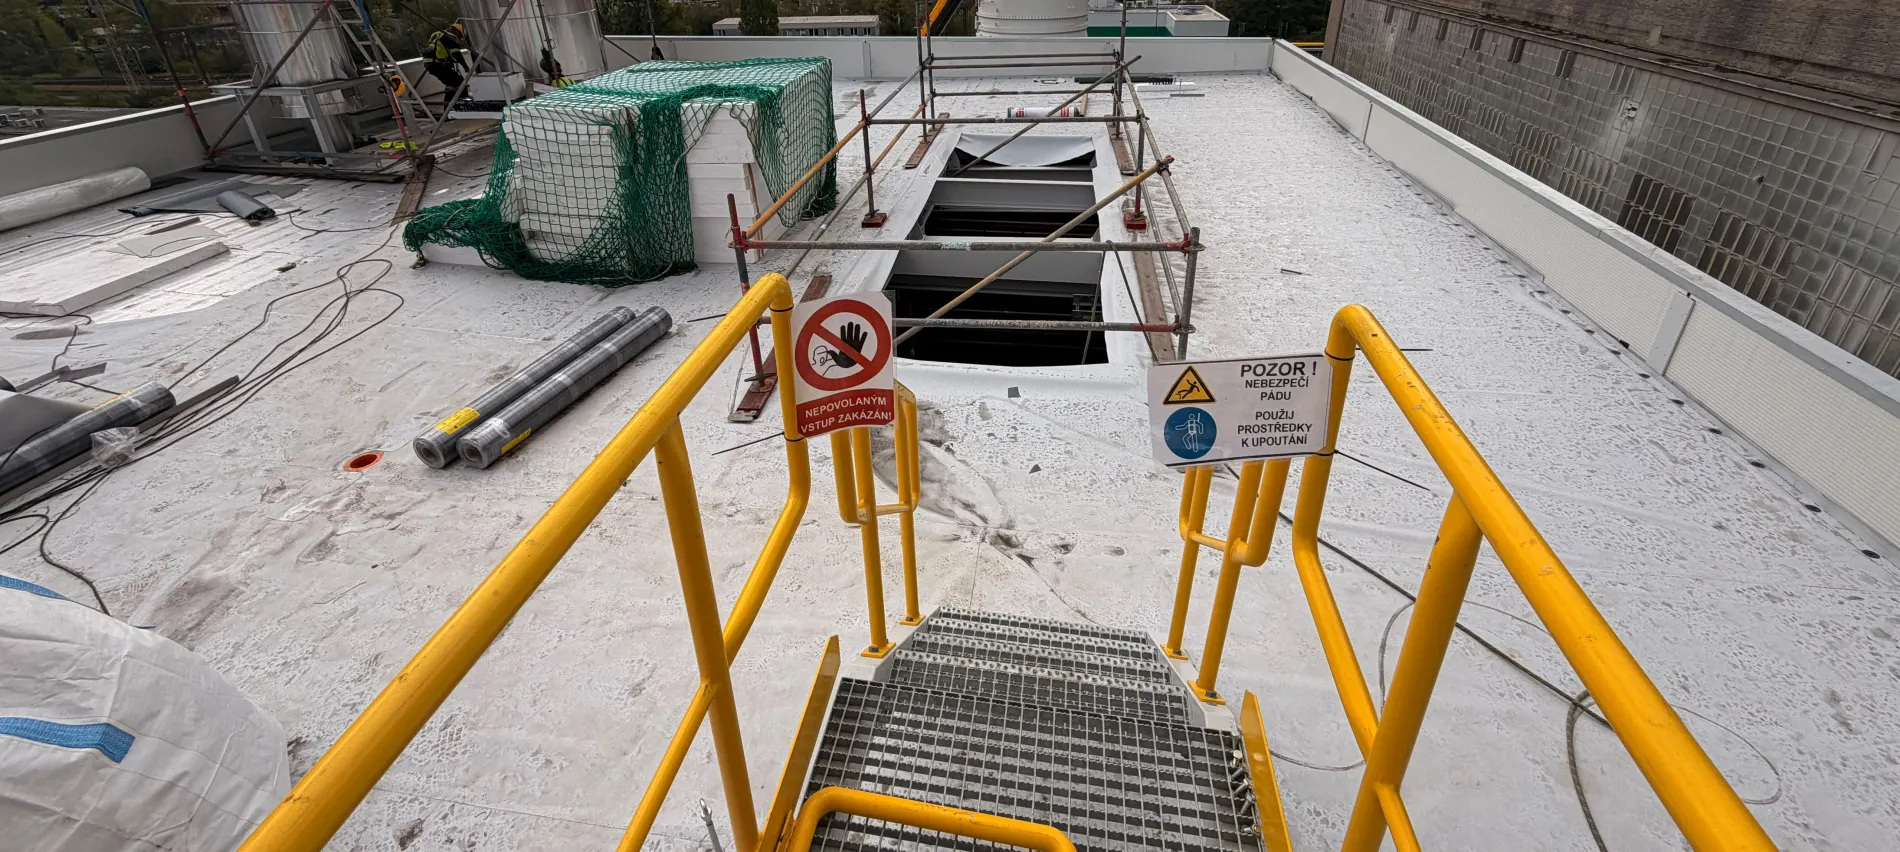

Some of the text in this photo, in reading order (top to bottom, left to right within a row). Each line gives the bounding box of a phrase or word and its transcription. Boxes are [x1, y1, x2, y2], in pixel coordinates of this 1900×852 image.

[1240, 361, 1317, 377] POZOR !
[1245, 376, 1309, 388] NEBEZPEČÍ
[1260, 390, 1292, 401] PÁDU
[805, 395, 887, 418] NEPOVOLANÝM
[1255, 409, 1295, 420] POUŽIJ
[800, 409, 892, 433] VSTUP ZAKÁZÁN!
[1237, 422, 1313, 434] PROSTŘEDKY
[1241, 434, 1308, 447] K UPOUTÁNÍ
